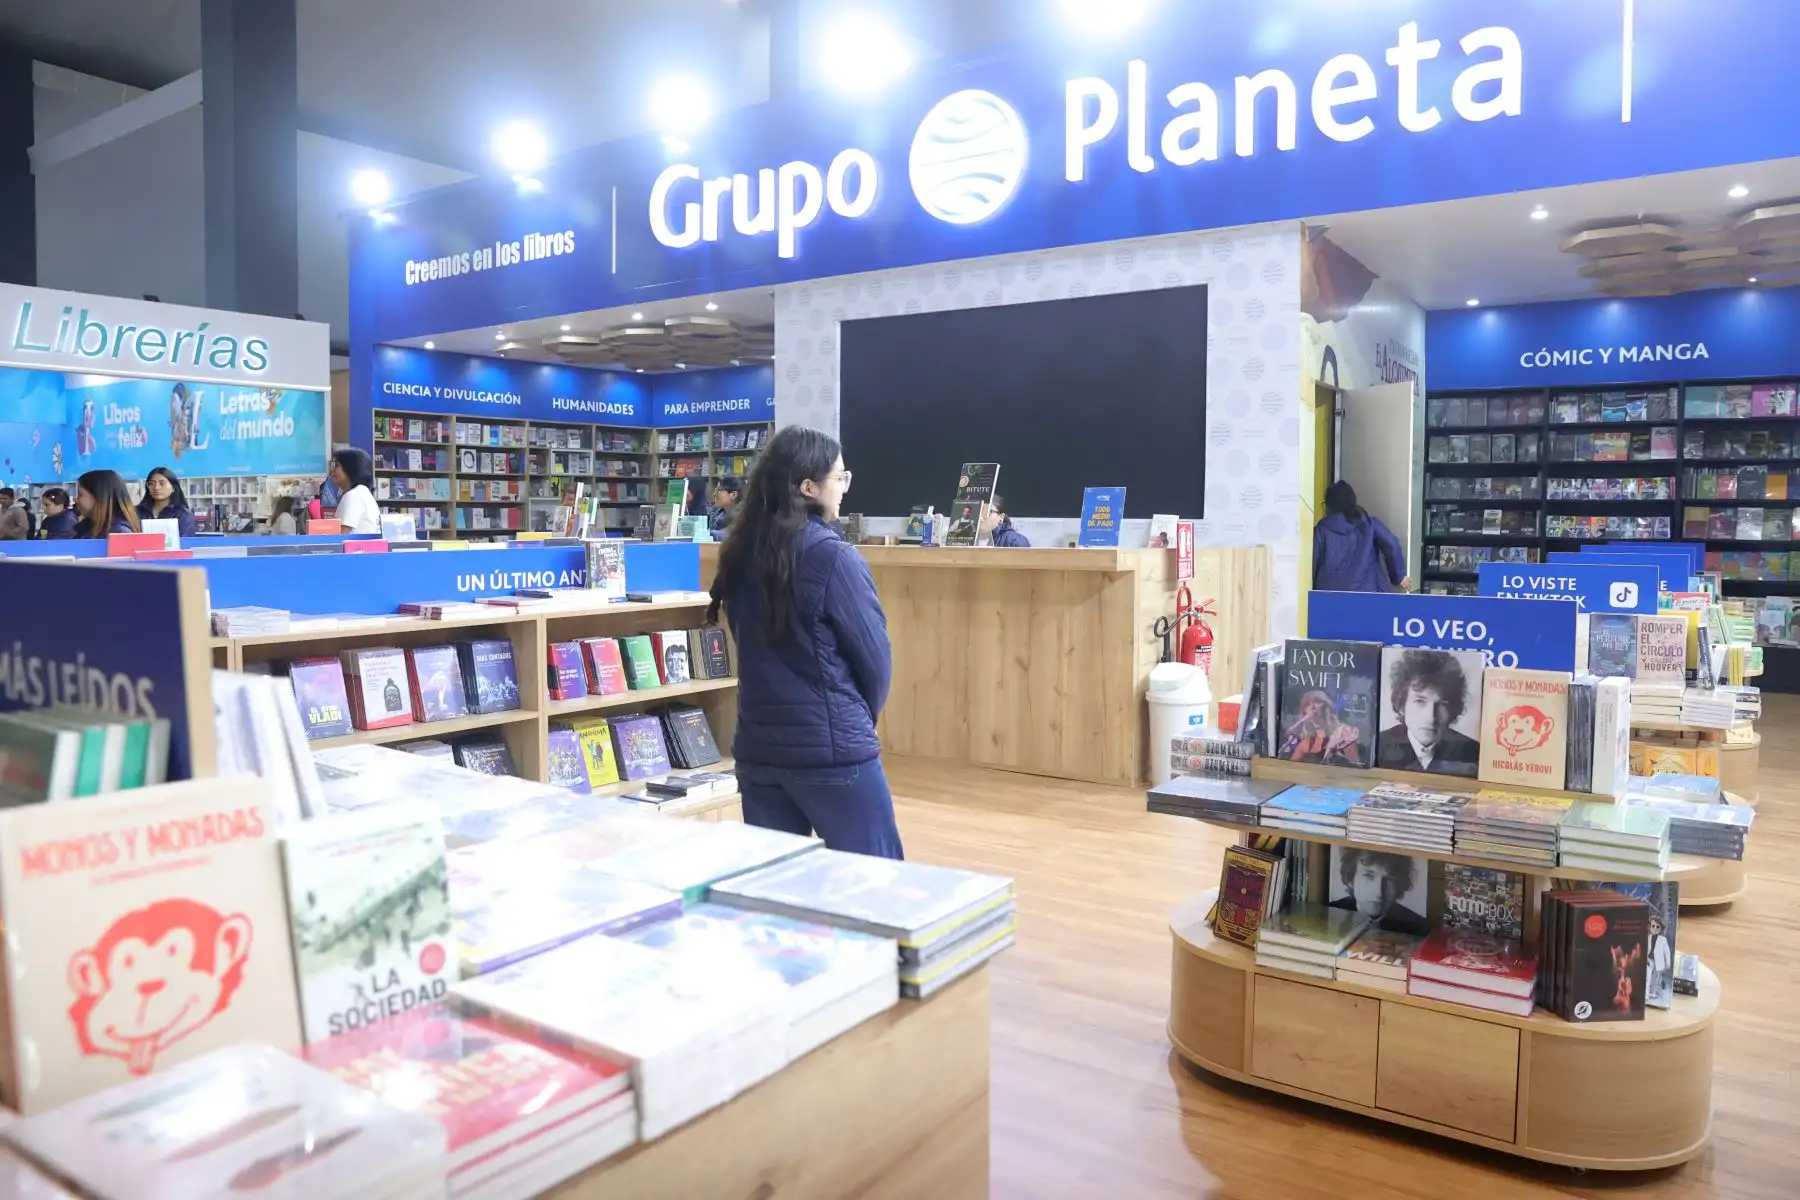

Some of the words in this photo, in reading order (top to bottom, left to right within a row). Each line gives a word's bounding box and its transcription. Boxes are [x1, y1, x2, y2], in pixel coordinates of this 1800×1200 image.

[649, 148, 878, 259] Grupo
[1065, 20, 1523, 182] Planeta
[405, 252, 470, 285] Creemos
[473, 247, 492, 272] en
[495, 241, 520, 267] los
[523, 230, 575, 262] libros
[13, 301, 270, 372] Librerías
[1520, 347, 1593, 368] CÓMIC
[1599, 347, 1613, 364] Y
[1618, 342, 1710, 363] MANGA
[219, 389, 271, 415] Letras
[382, 382, 431, 397] CIENCIA
[433, 387, 441, 398] Y
[443, 387, 521, 405] DIVULGACIÓN
[103, 402, 141, 426] Libros
[552, 397, 634, 416] HUMANIDADES
[664, 403, 689, 415] PARA
[691, 398, 750, 413] EMPRENDER
[219, 417, 236, 441] del
[237, 411, 295, 439] mundo
[456, 574, 485, 592] UN
[490, 568, 555, 589] ÚLTIMO
[1502, 575, 1524, 589] LO
[1528, 576, 1577, 591] VISTE
[1393, 617, 1425, 637] LO
[1432, 619, 1494, 646] VEO,
[1641, 622, 1683, 634] ROMPER
[1641, 634, 1652, 645] EL
[1293, 648, 1356, 669] TAYLOR
[1644, 663, 1678, 672] HOOVER
[47, 652, 159, 724] LEÍDOS
[1289, 669, 1341, 689] SWIFT
[1525, 680, 1566, 694] MONADAS
[1492, 759, 1524, 771] NICOLÁS
[21, 831, 120, 881] MONOS
[121, 827, 141, 860] Y
[147, 807, 265, 857] MONADAS
[371, 968, 401, 994] LA
[328, 978, 447, 1036] SOCIEDAD
